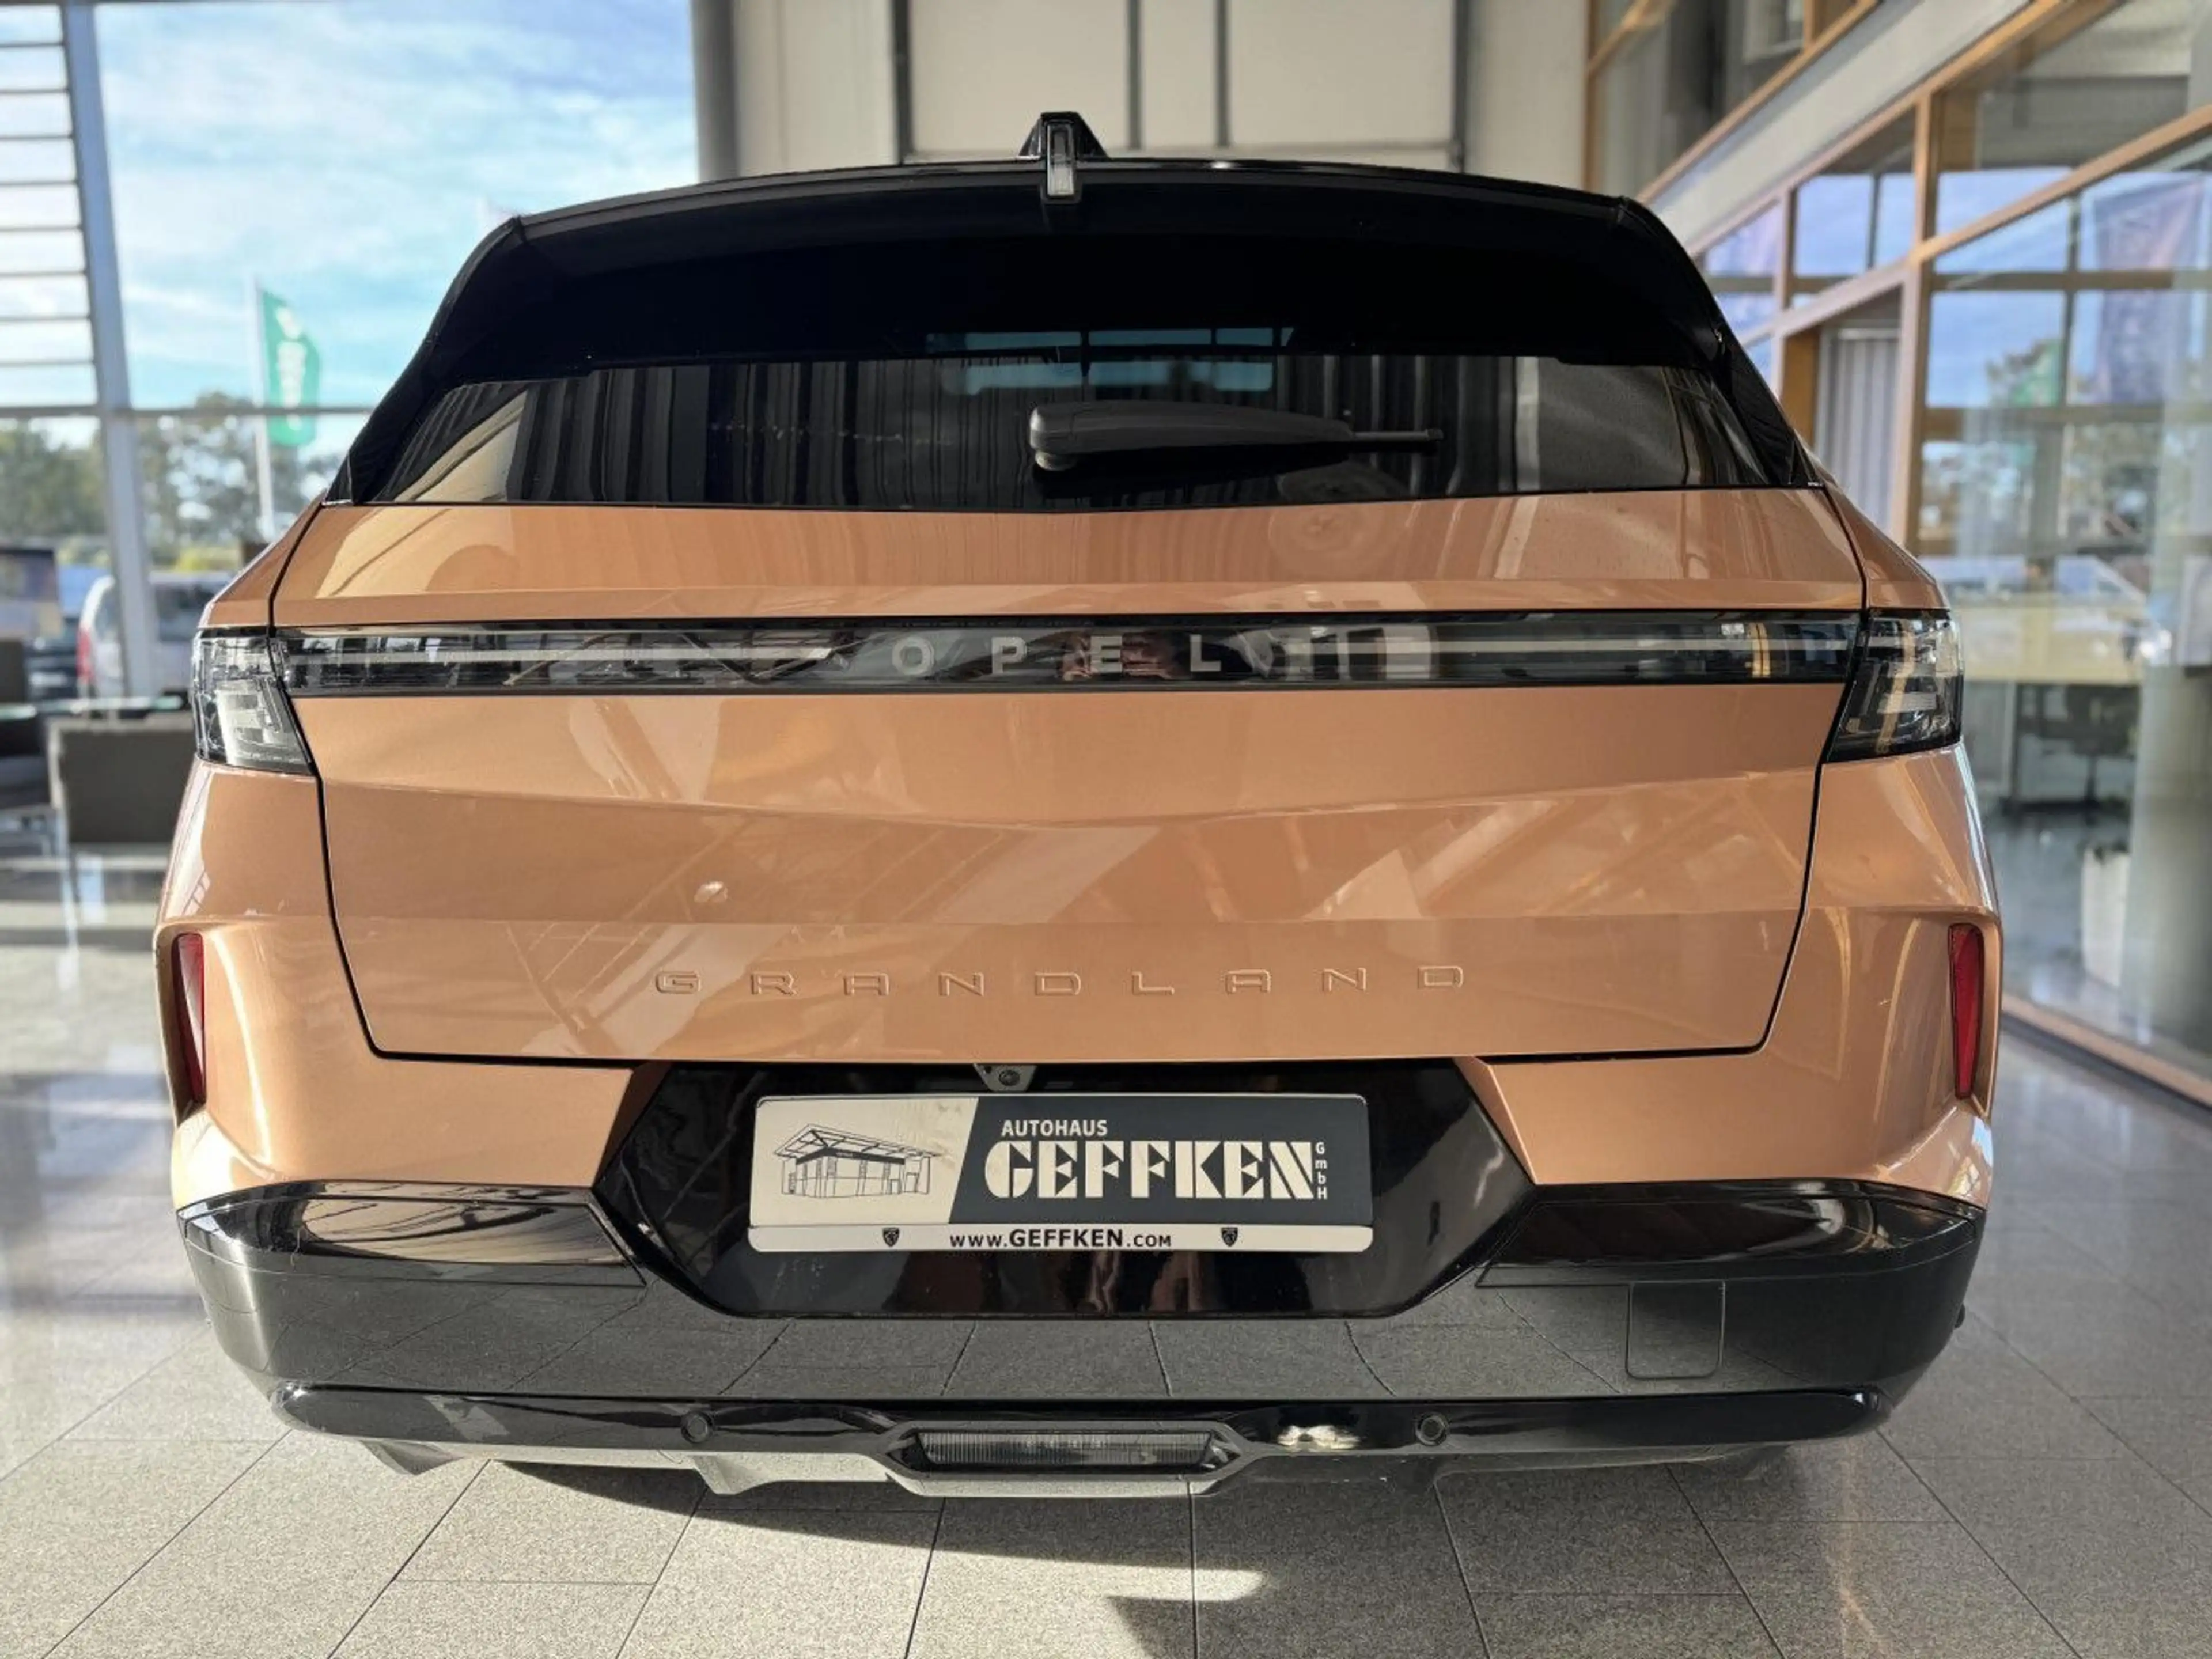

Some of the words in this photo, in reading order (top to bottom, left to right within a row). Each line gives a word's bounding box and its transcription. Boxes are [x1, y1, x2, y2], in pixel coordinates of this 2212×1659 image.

[892, 634, 1221, 675] OPEL
[656, 964, 1464, 996] GRANDLAND
[1001, 1120, 1108, 1137] AUTOHAUS
[984, 1141, 1314, 1200] GEFFKEN
[1315, 1141, 1328, 1200] GmbH
